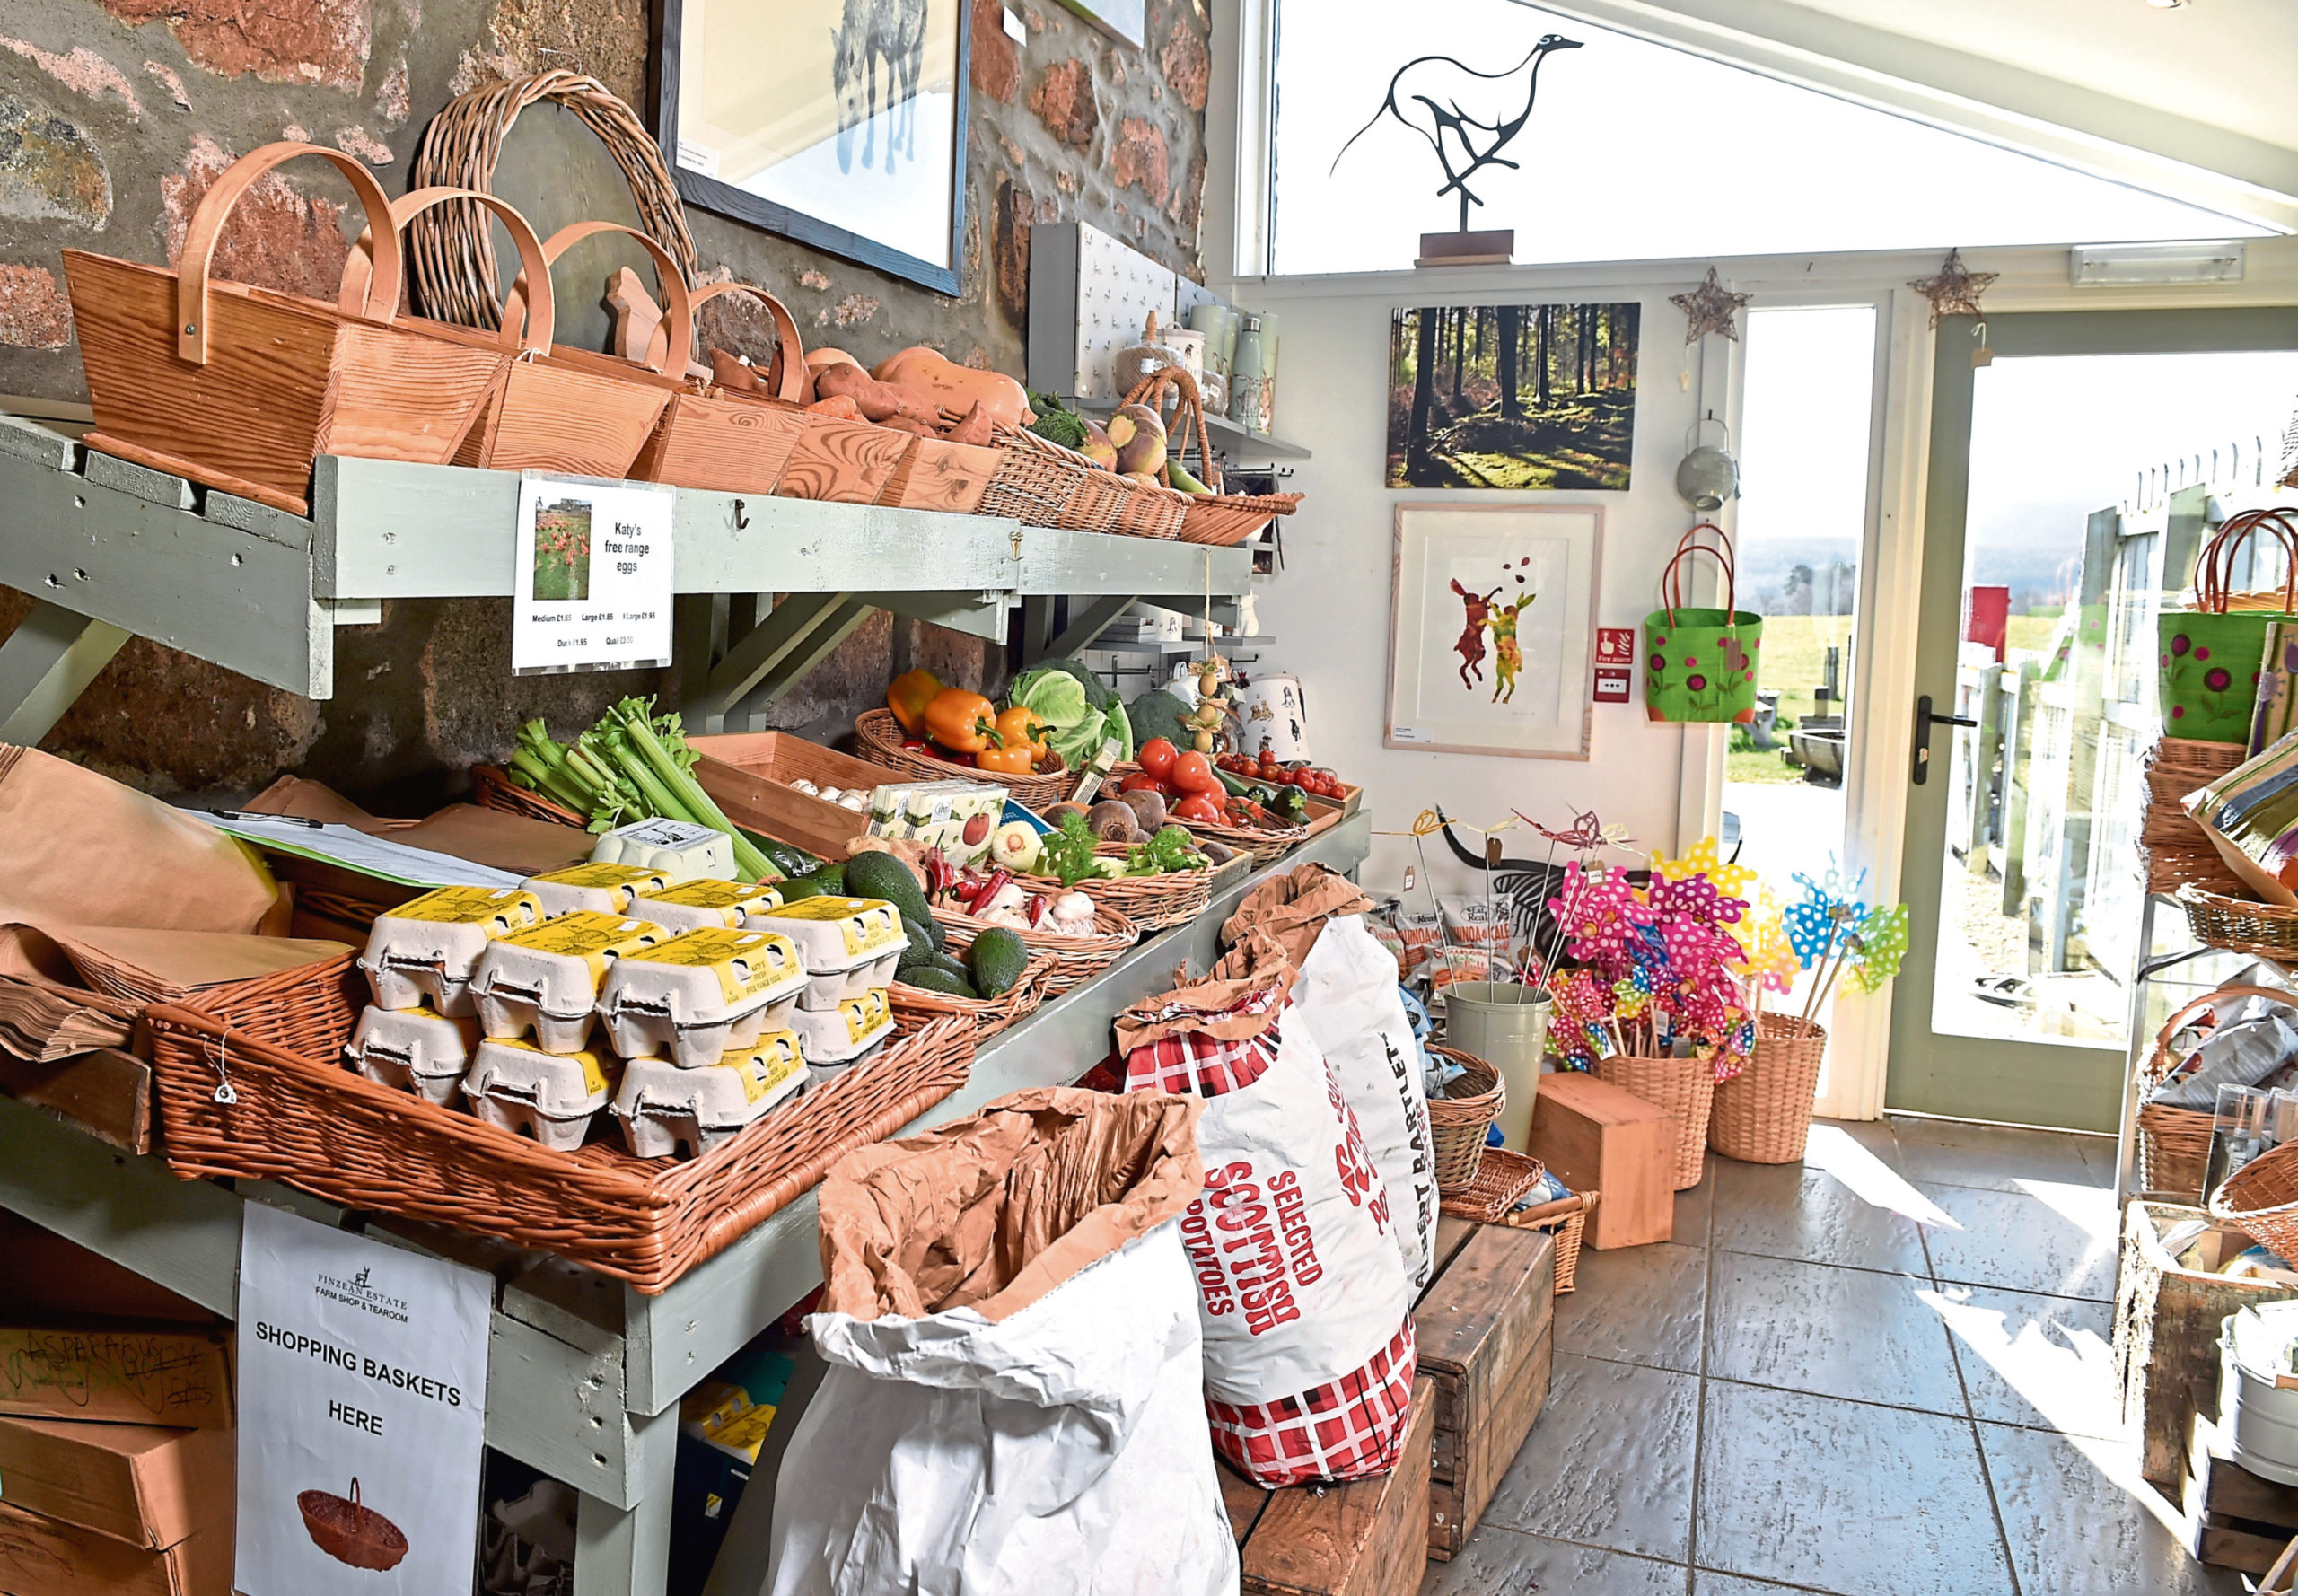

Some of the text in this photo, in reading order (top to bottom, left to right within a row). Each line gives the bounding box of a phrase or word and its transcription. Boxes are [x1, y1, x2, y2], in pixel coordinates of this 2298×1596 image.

[605, 540, 649, 557] free range
[615, 522, 641, 539] Katy's
[617, 562, 637, 574] eggs
[532, 614, 556, 622] Medium
[582, 614, 598, 622] Large
[1468, 911, 1488, 921] Real
[1267, 1171, 1323, 1287] SELECTED
[1181, 1199, 1235, 1316] POTATOES
[1205, 1162, 1301, 1336] SCOTTISH
[316, 1286, 408, 1323] FARM SHOP & TEAROOM
[317, 1274, 408, 1311] FINZEAN ESTATE
[256, 1321, 357, 1371] SHOPPING
[363, 1358, 460, 1407] BASKETS
[329, 1400, 382, 1436] HERE
